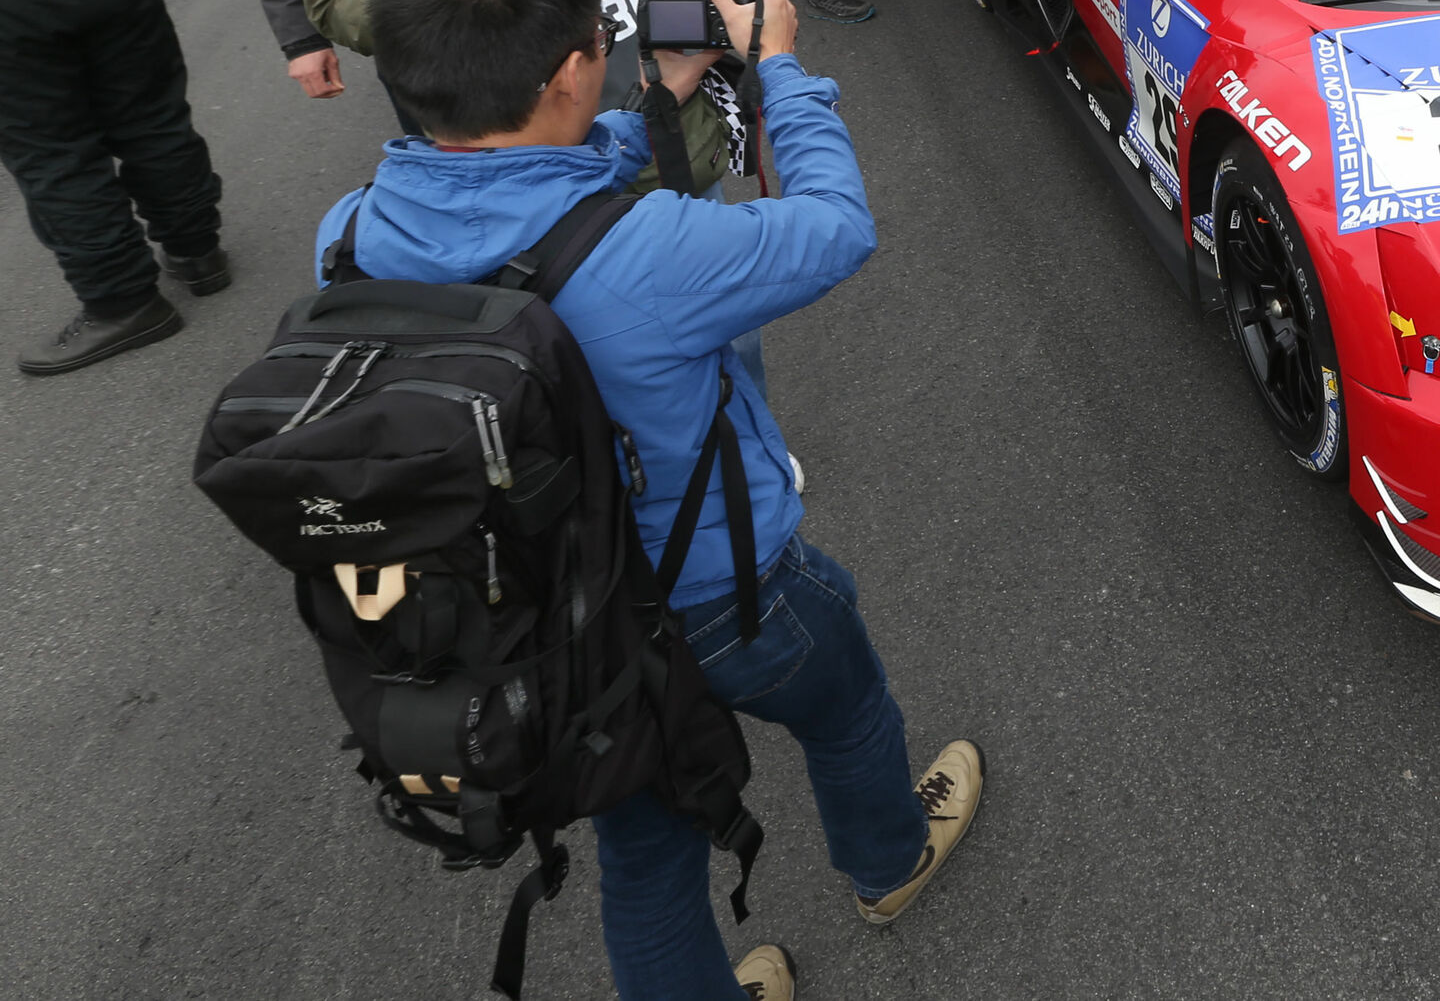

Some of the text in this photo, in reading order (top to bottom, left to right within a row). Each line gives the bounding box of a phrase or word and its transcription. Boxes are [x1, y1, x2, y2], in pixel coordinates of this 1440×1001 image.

[1136, 27, 1186, 94] ZURICH
[1215, 70, 1312, 172] FALKEN
[1340, 197, 1400, 231] 24h
[1315, 405, 1338, 471] MICHELIN
